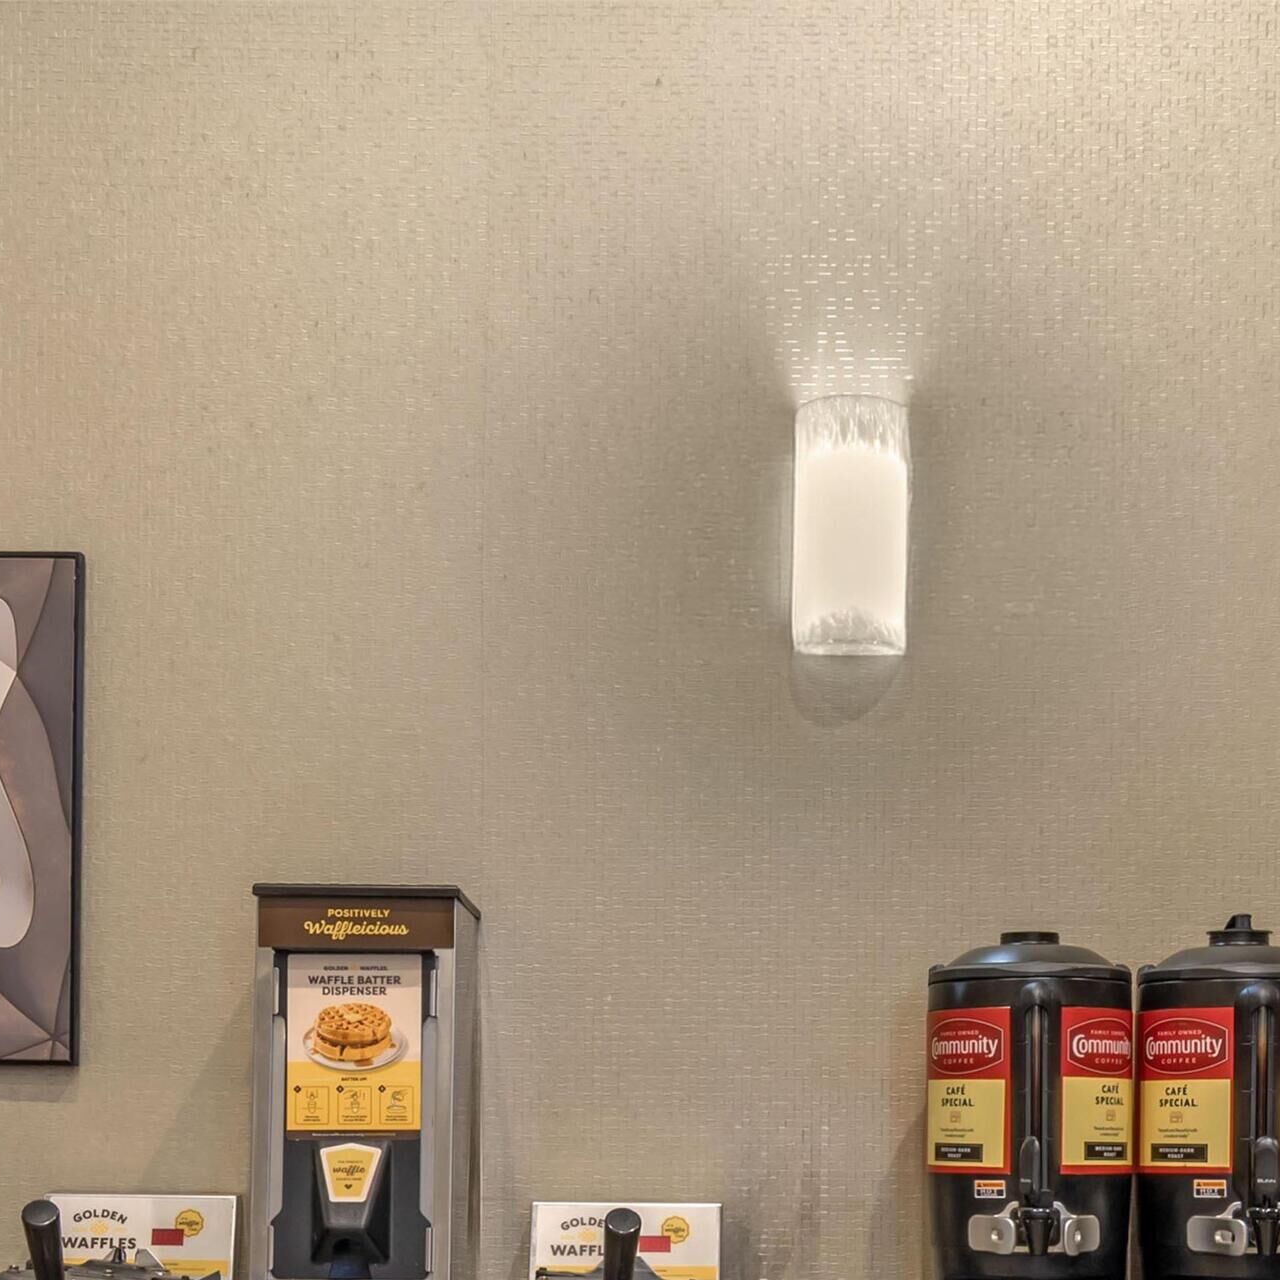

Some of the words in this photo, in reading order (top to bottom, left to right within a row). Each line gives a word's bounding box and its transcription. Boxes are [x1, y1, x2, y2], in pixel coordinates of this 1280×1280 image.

[327, 909, 390, 918] POSITIVELY
[303, 920, 409, 940] Waffleicious
[308, 976, 355, 985] WAFFLE
[357, 976, 401, 985] BATTER
[322, 986, 387, 996] DISPENSER
[931, 1034, 999, 1060] Community
[1145, 1034, 1223, 1060] Community
[943, 1057, 974, 1065] COFFEE
[1161, 1056, 1197, 1065] COFFEE
[946, 1084, 965, 1096] CAFÉ
[1101, 1082, 1120, 1094] CAFÉ
[1165, 1084, 1188, 1096] CAFÉ
[332, 1165, 366, 1176] waffle
[73, 1209, 128, 1225] GOLDEN
[560, 1216, 605, 1231] GOLDE
[62, 1236, 137, 1250] WAFFLES
[550, 1244, 605, 1257] WAFFL
